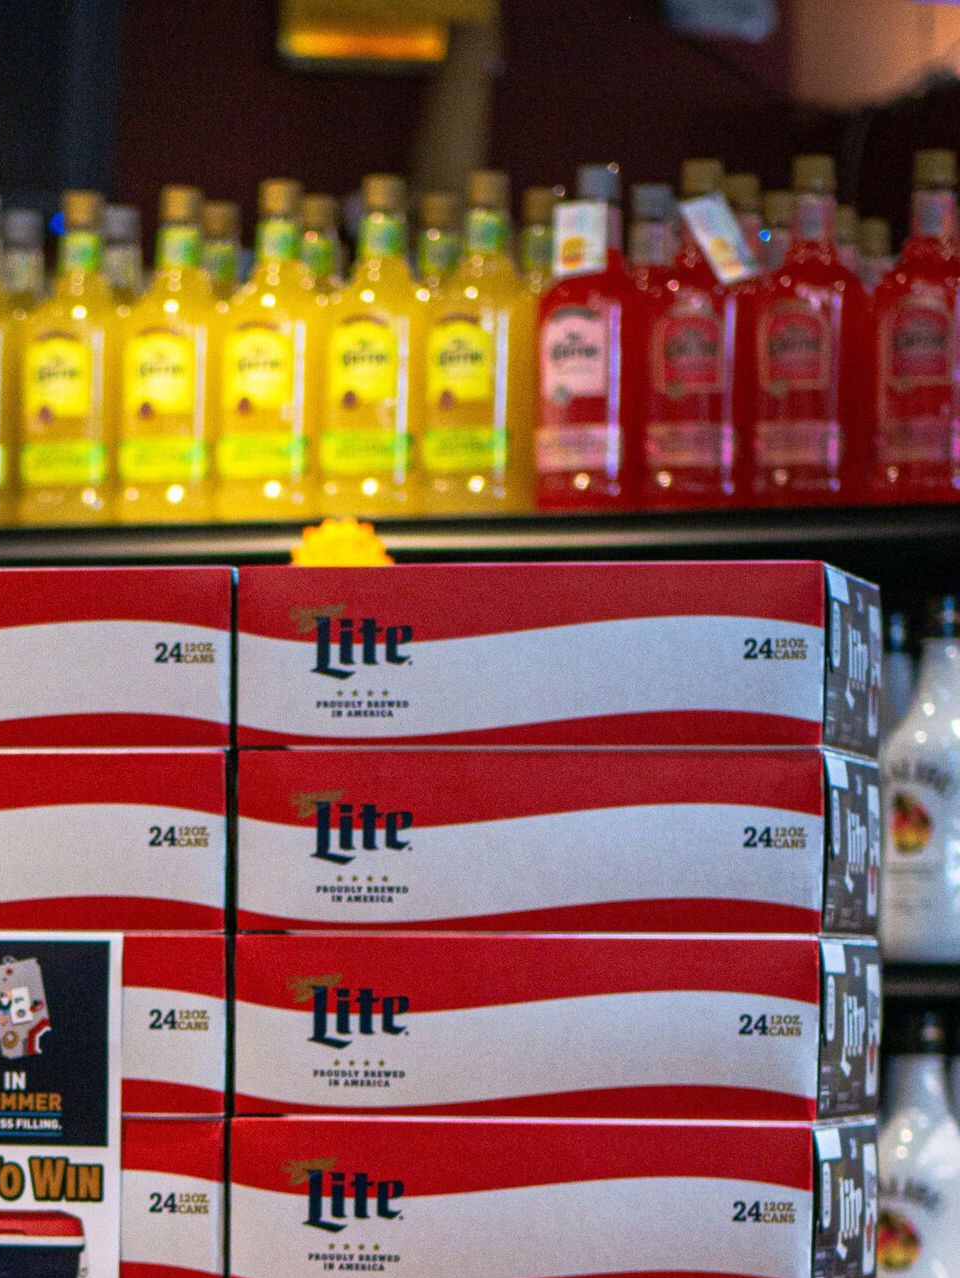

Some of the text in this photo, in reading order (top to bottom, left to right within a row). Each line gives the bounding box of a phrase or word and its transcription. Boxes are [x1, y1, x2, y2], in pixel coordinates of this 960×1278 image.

[155, 642, 183, 663] 24
[311, 614, 411, 681] Lite
[744, 637, 774, 660] 24
[773, 649, 806, 662] CANS
[182, 653, 213, 664] CANS
[149, 826, 177, 847] 24
[176, 837, 207, 848] CANS
[311, 798, 411, 866] Lite
[743, 826, 773, 848] 24
[772, 838, 805, 850] CANS
[149, 1008, 177, 1030] 24
[176, 1019, 207, 1032] CANS
[308, 983, 408, 1051] Lite
[738, 1013, 768, 1035] 24
[767, 1025, 800, 1036] CANS
[4, 1070, 26, 1090] IN
[16, 1118, 63, 1131] FILLING.
[29, 1156, 104, 1203] WIN
[149, 1192, 177, 1213] 24
[176, 1203, 207, 1214] CANS
[303, 1167, 403, 1234] Lite
[732, 1200, 762, 1222] 24
[761, 1212, 794, 1224] CANS
